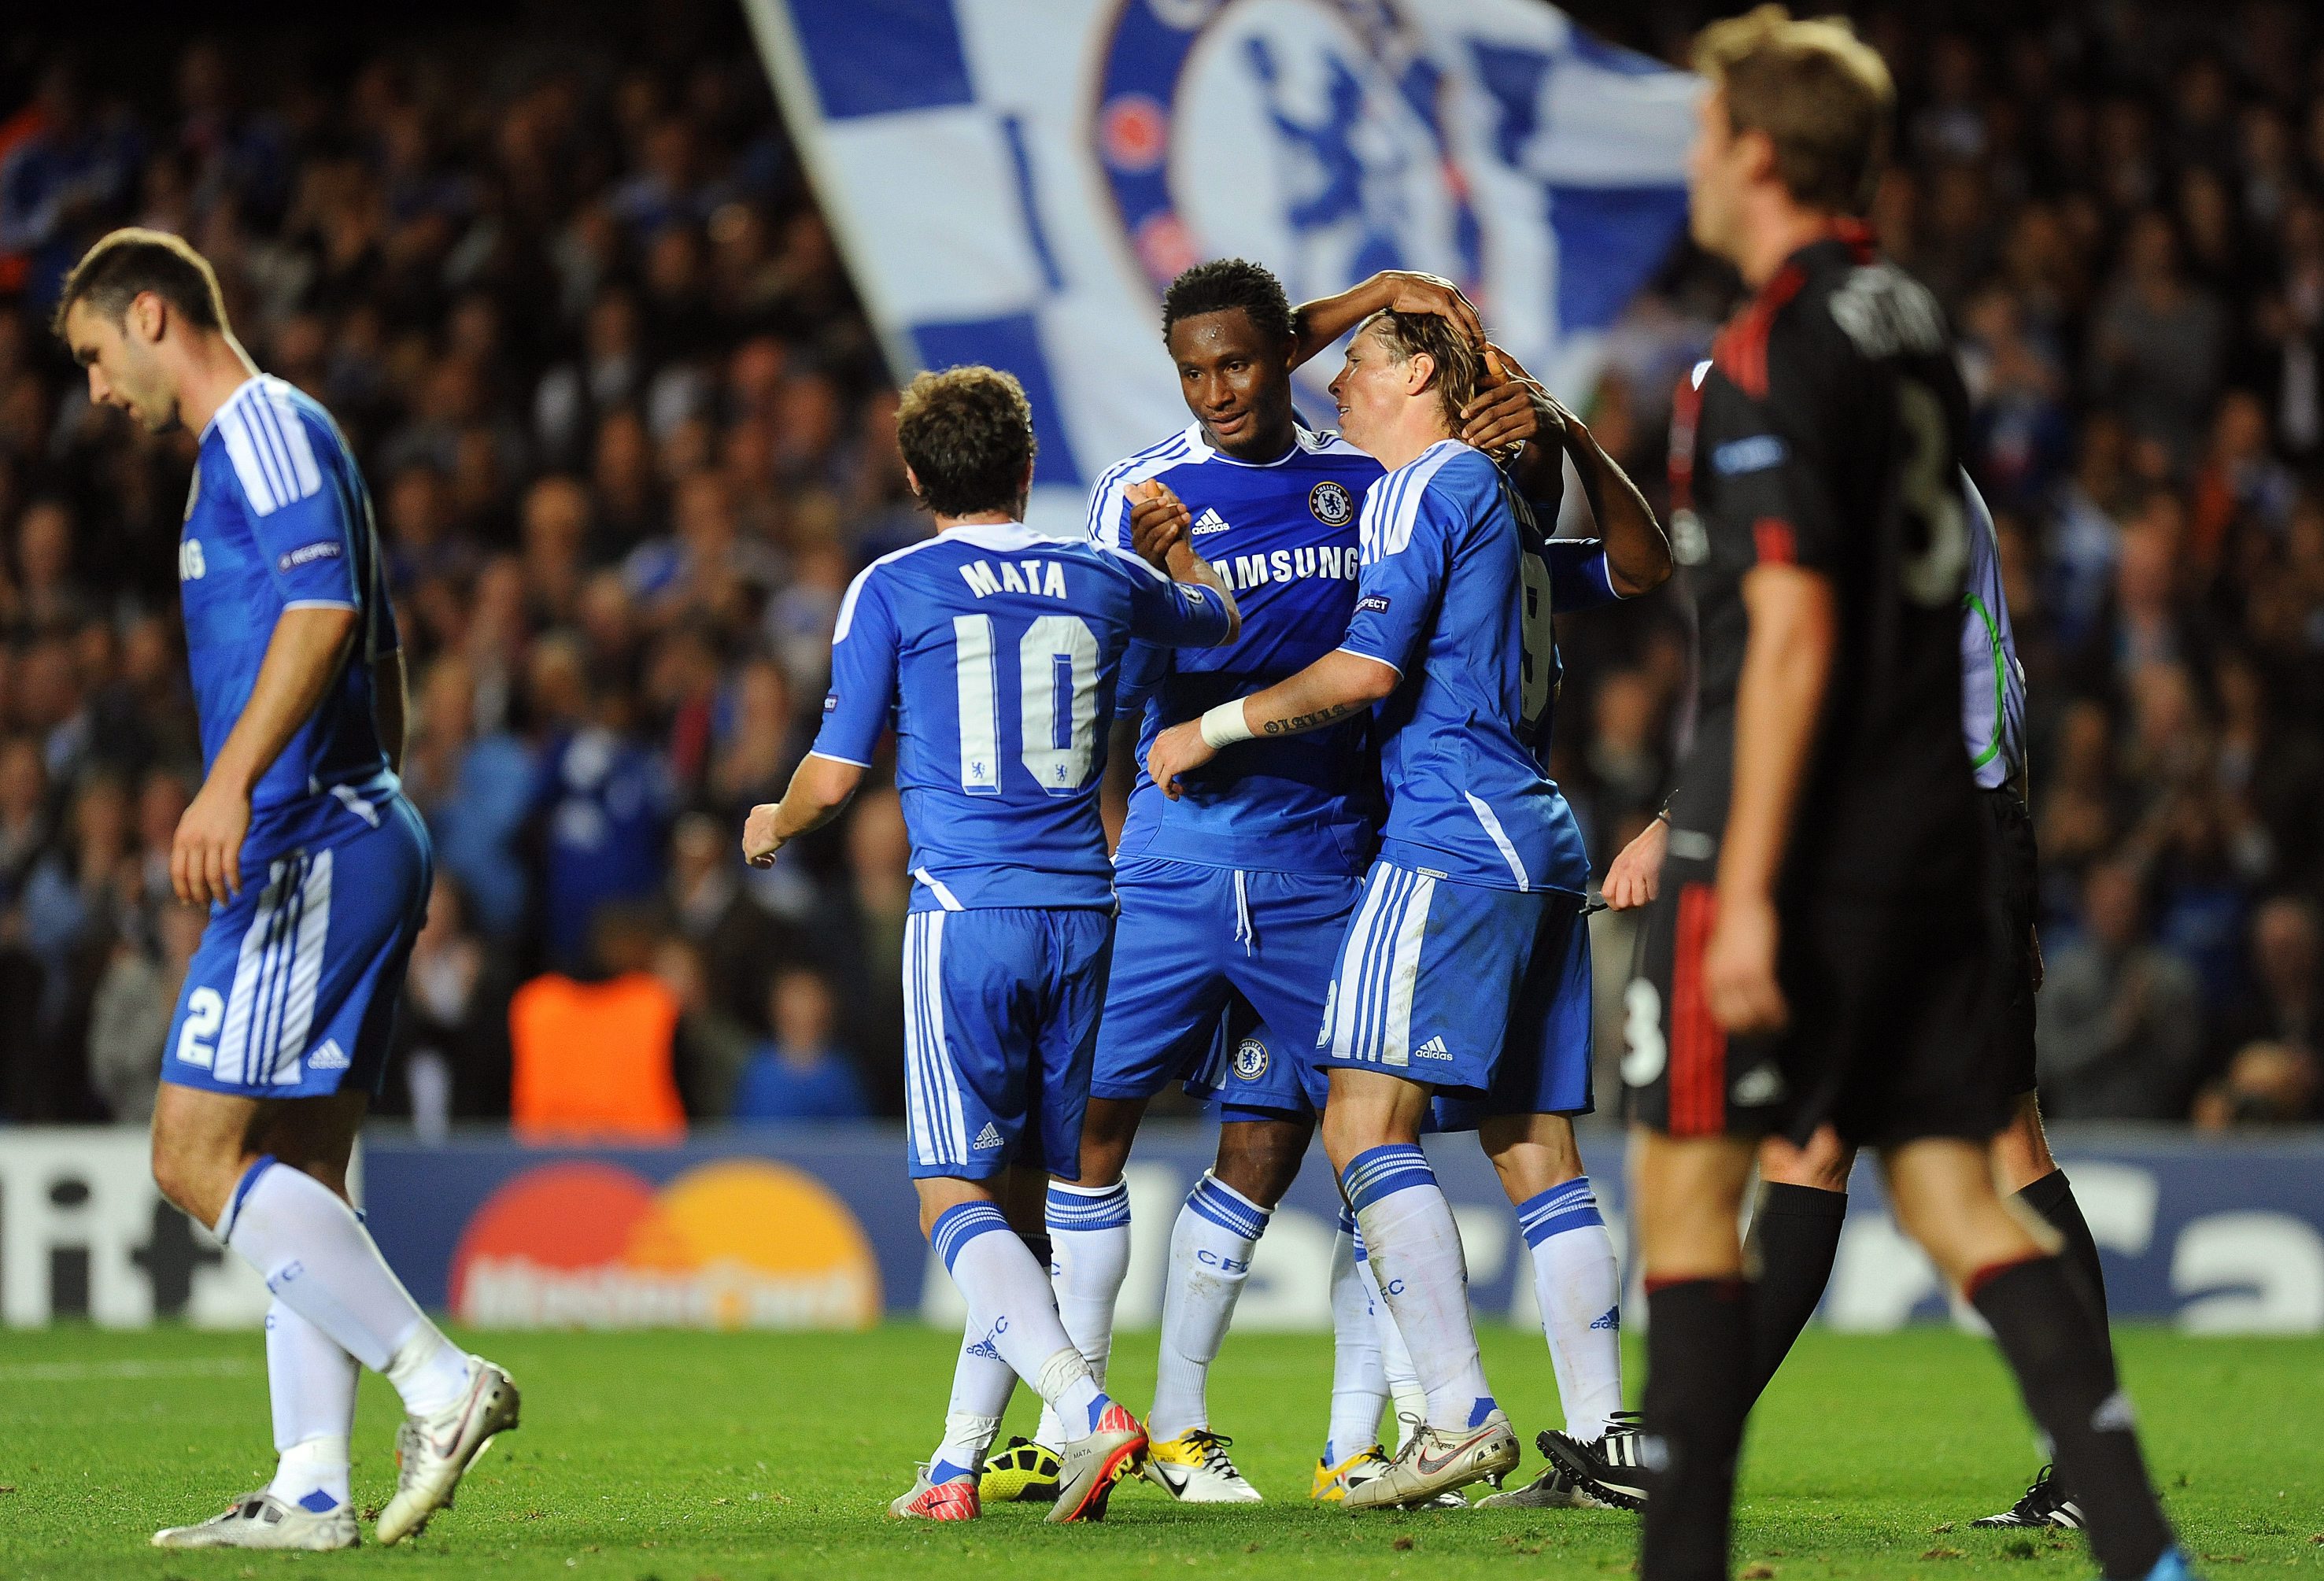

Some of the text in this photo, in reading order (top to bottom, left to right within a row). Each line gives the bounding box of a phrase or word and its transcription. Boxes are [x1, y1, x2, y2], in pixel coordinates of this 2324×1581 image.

[1315, 485, 1341, 495] CHELSEA
[1192, 523, 1230, 535] adidas
[1212, 546, 1358, 591] AMSUNG
[959, 559, 1067, 600] MATA
[952, 613, 1103, 797] 10
[176, 985, 224, 1070] 2
[1239, 1041, 1261, 1051] CHELSEA
[1415, 1049, 1454, 1062] adidas
[973, 1137, 1005, 1151] adidas
[1197, 1250, 1250, 1273] CFC
[1073, 1448, 1092, 1460] MATA
